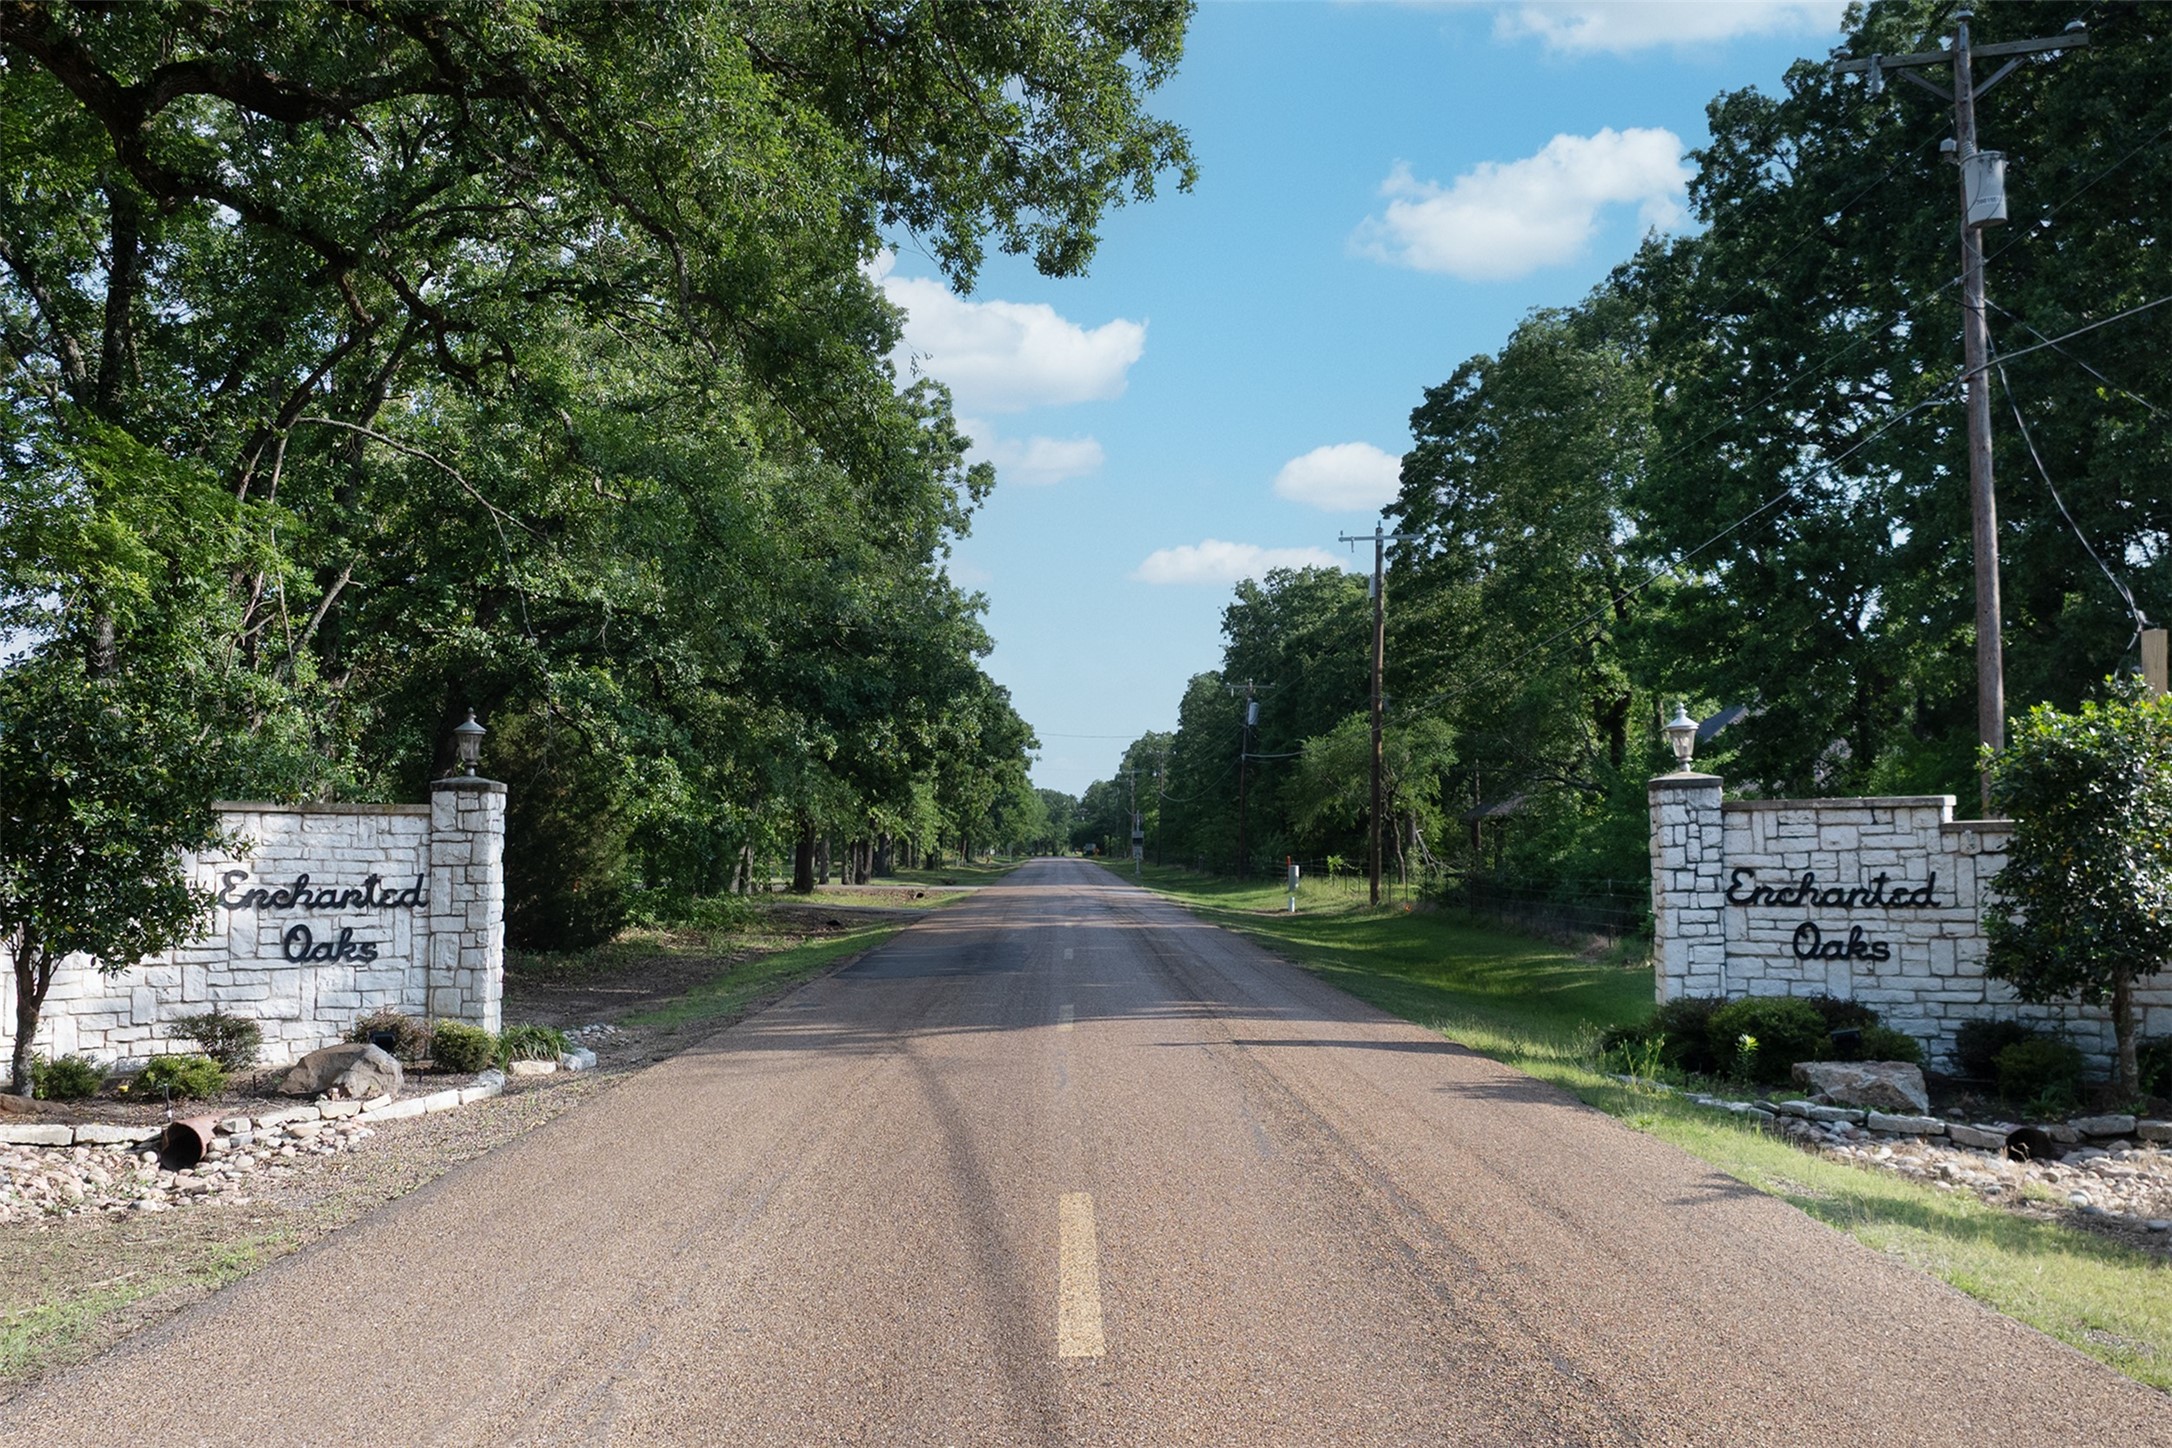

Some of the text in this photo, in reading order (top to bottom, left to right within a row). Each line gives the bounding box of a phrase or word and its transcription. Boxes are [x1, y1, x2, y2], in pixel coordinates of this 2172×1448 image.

[219, 869, 430, 911] Enchanted
[1726, 867, 1942, 908] Enchanted
[284, 924, 379, 964] Oaks
[1793, 921, 1891, 962] Oaks
